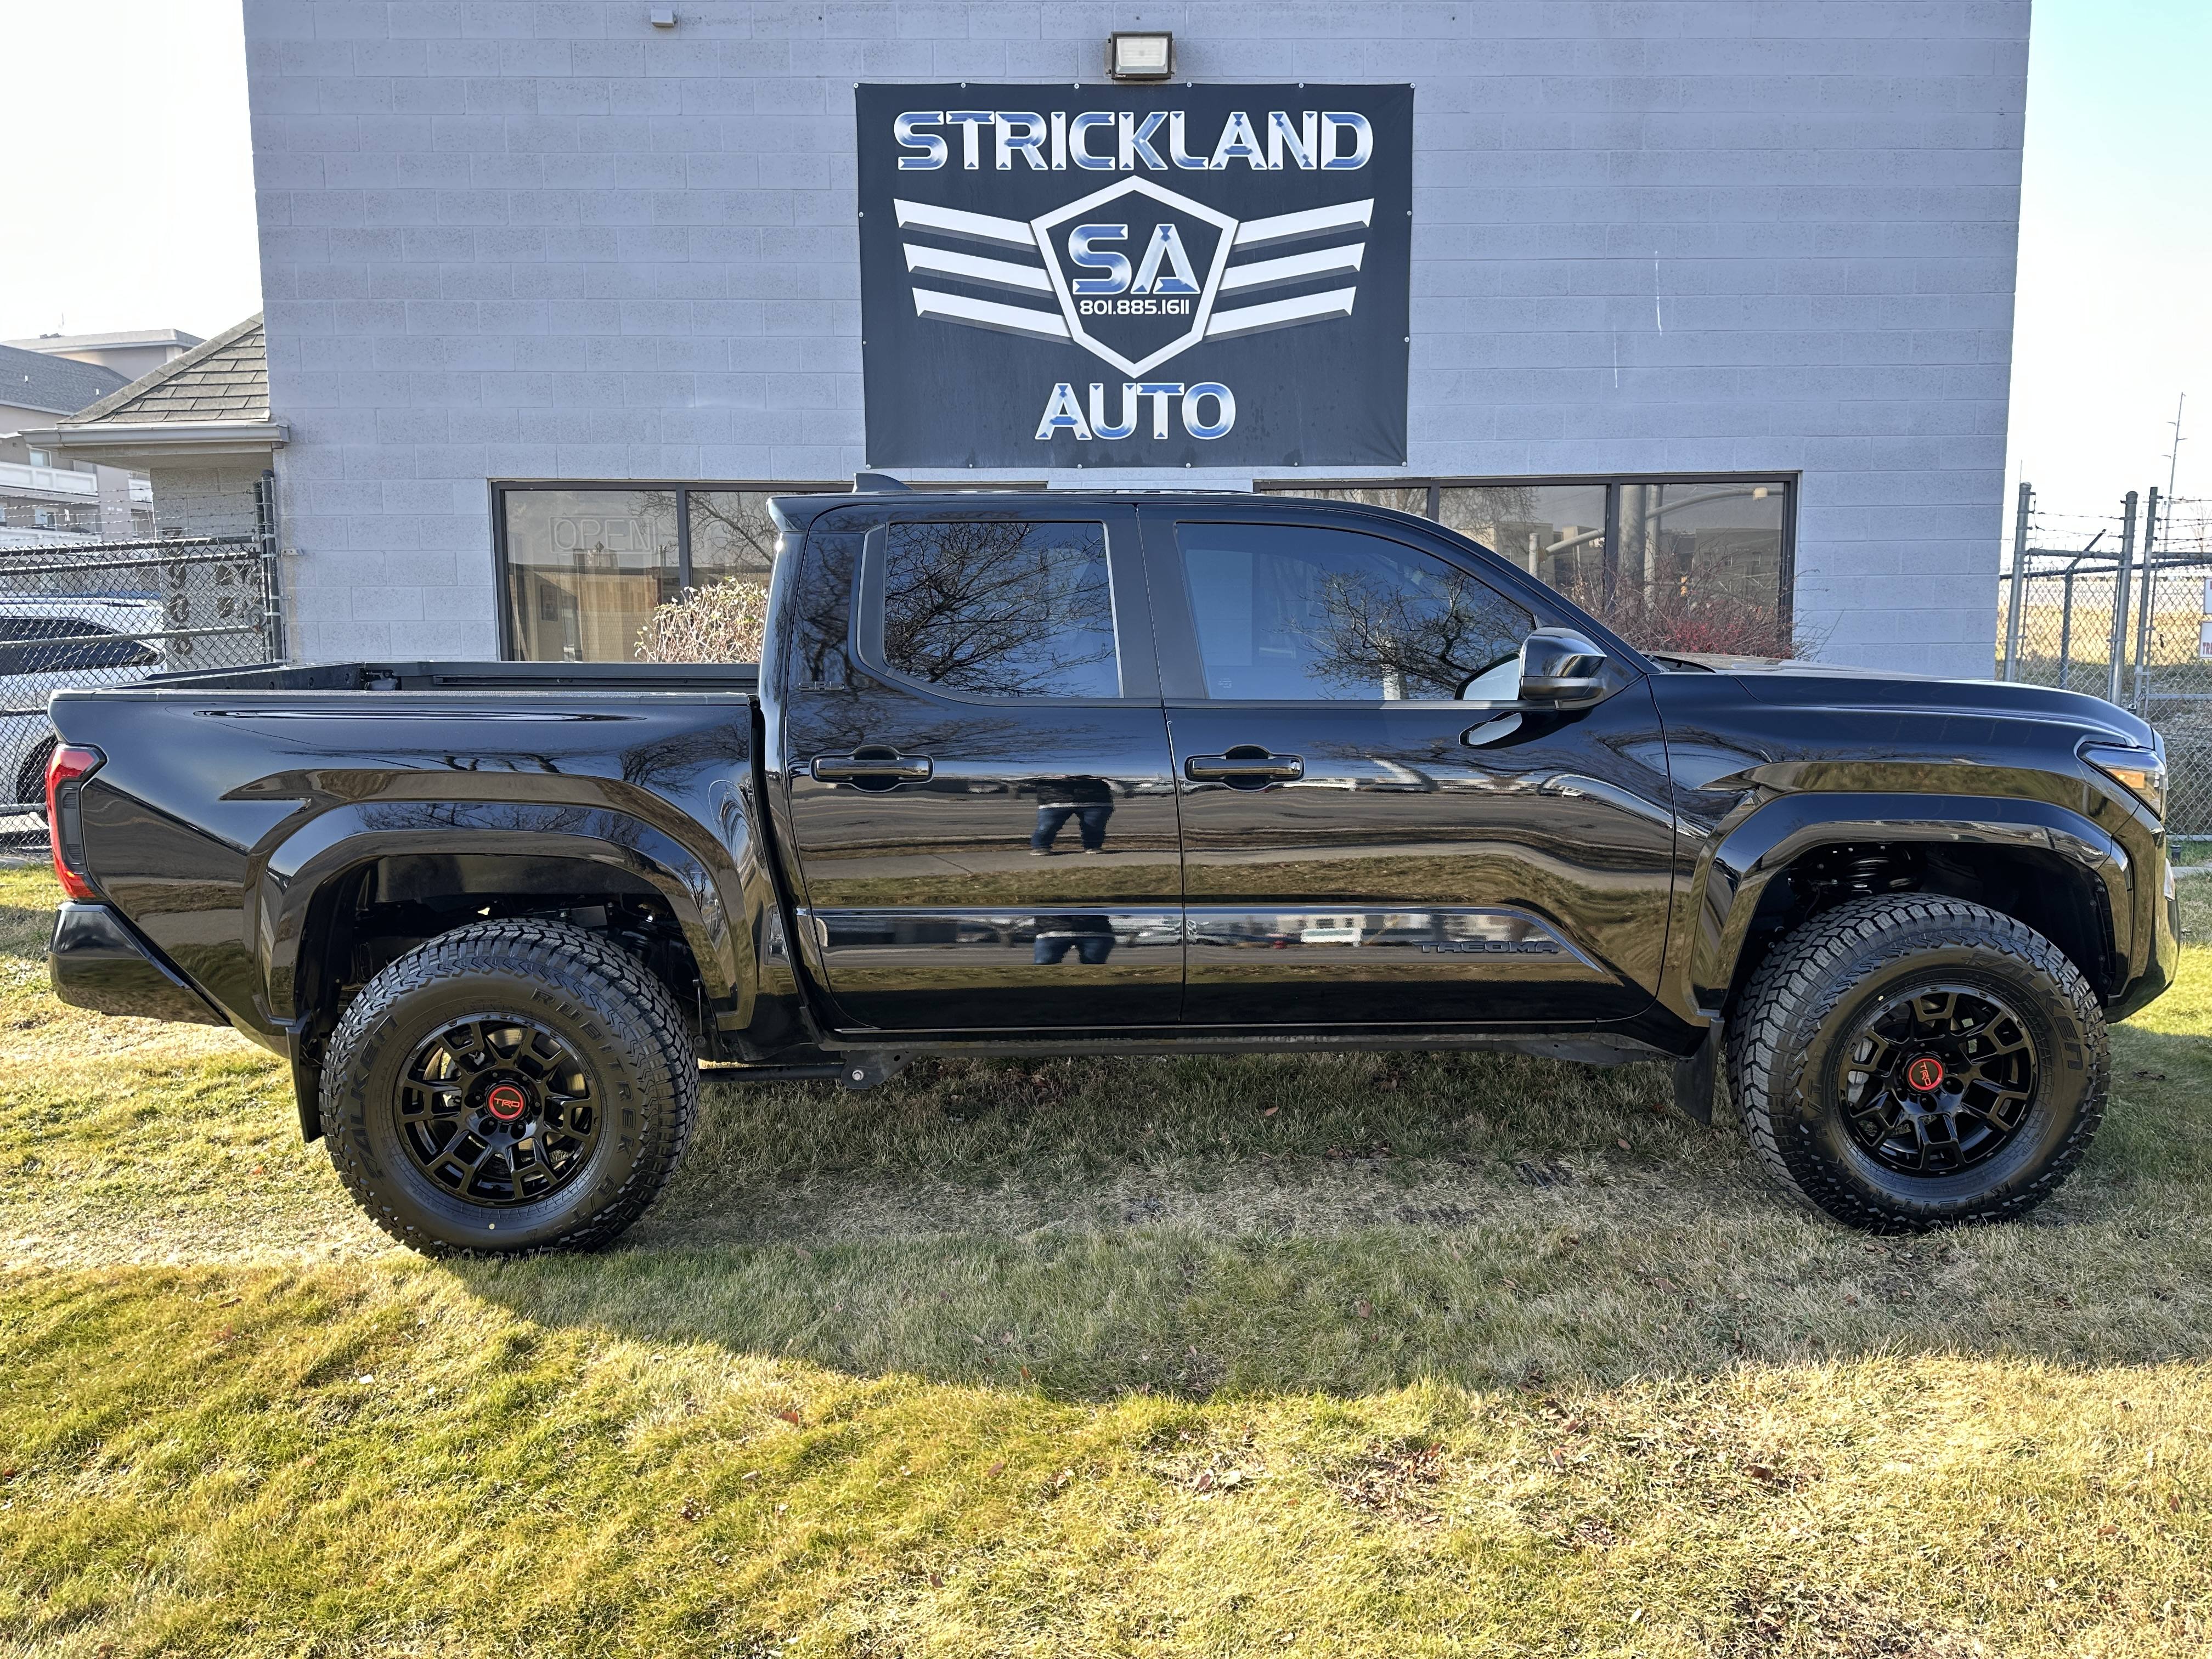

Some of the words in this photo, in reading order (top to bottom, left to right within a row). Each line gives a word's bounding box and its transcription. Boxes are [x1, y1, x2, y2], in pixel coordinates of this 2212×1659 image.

[893, 111, 1374, 171] STRICKLAND
[1068, 223, 1201, 295] SA
[1079, 299, 1189, 315] 801.885.1611
[1035, 382, 1236, 440] AUTO
[554, 518, 651, 550] OPEN
[798, 681, 845, 691] SR5
[1412, 940, 1560, 954] TACOMA
[530, 988, 637, 1160] RUBITREK
[1919, 1061, 1932, 1086] TRD
[494, 1098, 520, 1109] TRD
[1832, 1156, 2013, 1216] RUBITREK
